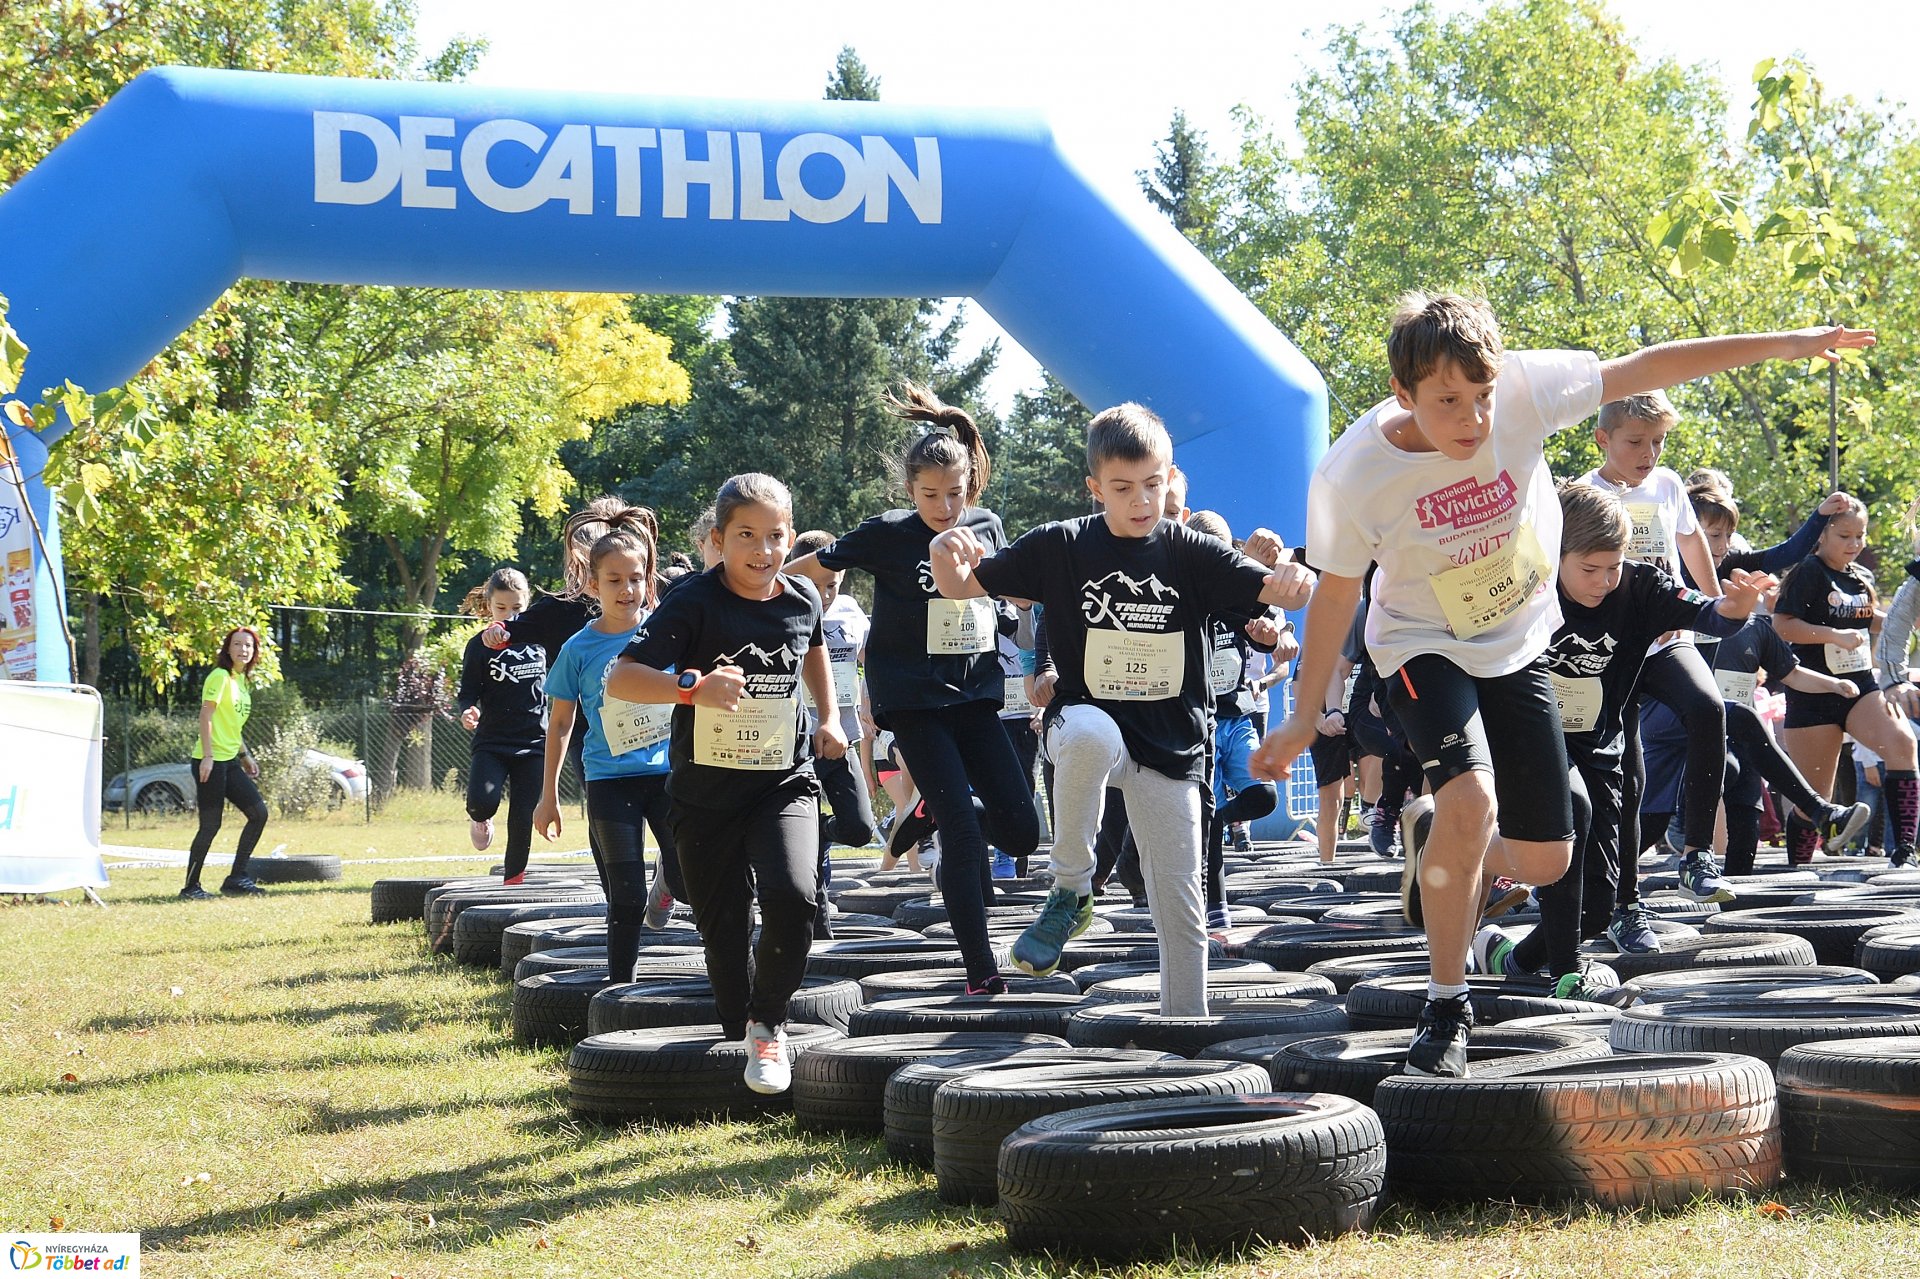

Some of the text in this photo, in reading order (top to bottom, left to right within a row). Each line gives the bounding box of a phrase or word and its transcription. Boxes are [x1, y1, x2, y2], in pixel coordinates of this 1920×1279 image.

[313, 110, 942, 224] DECATHLON
[1433, 481, 1477, 504] Telekom
[1457, 497, 1514, 527] Félmaraton
[1439, 512, 1514, 546] BUDAPEST 2017
[1632, 526, 1650, 535] 043
[1488, 575, 1514, 597] 084
[1119, 612, 1168, 623] TRAIL
[1855, 606, 1872, 618] KID
[961, 622, 975, 632] 109
[1125, 662, 1148, 674] 125
[1210, 669, 1225, 678] 014
[1736, 690, 1749, 698] 259
[633, 715, 652, 727] 021
[736, 730, 760, 741] 119
[1899, 780, 1919, 844] SPARTA
